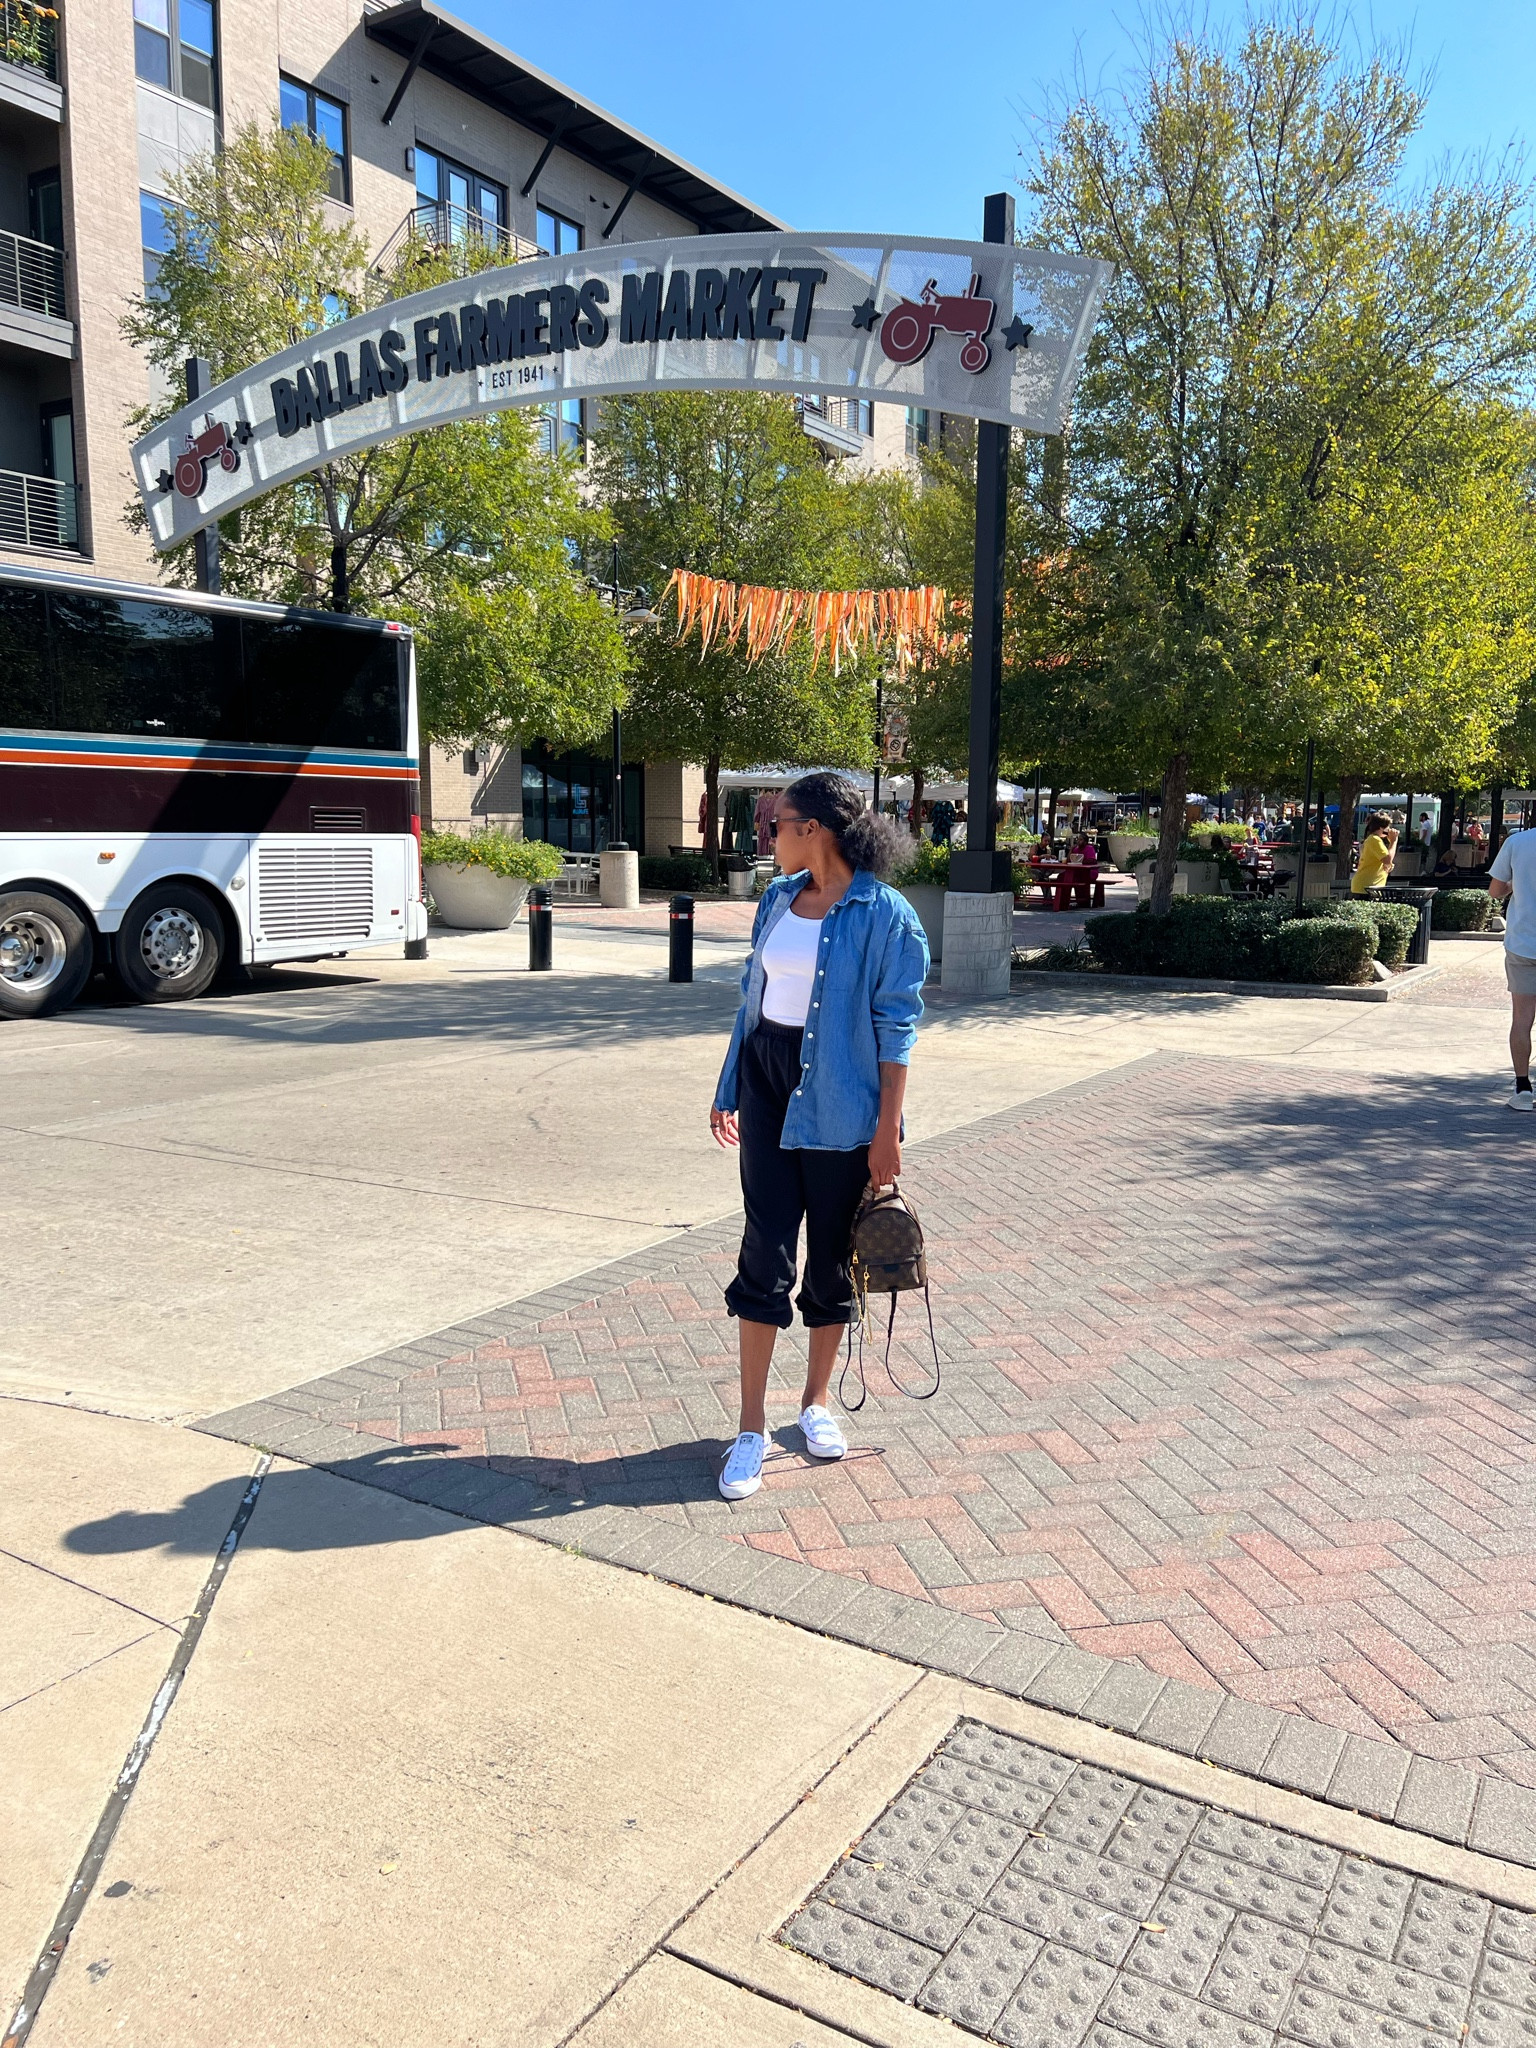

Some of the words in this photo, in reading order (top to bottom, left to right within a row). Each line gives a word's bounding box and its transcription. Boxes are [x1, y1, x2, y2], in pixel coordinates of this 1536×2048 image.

[270, 330, 408, 438] DALLAS
[414, 279, 609, 382] FARMERS
[620, 268, 827, 343] MARKET
[492, 370, 512, 388] EST
[518, 365, 543, 384] 1941
